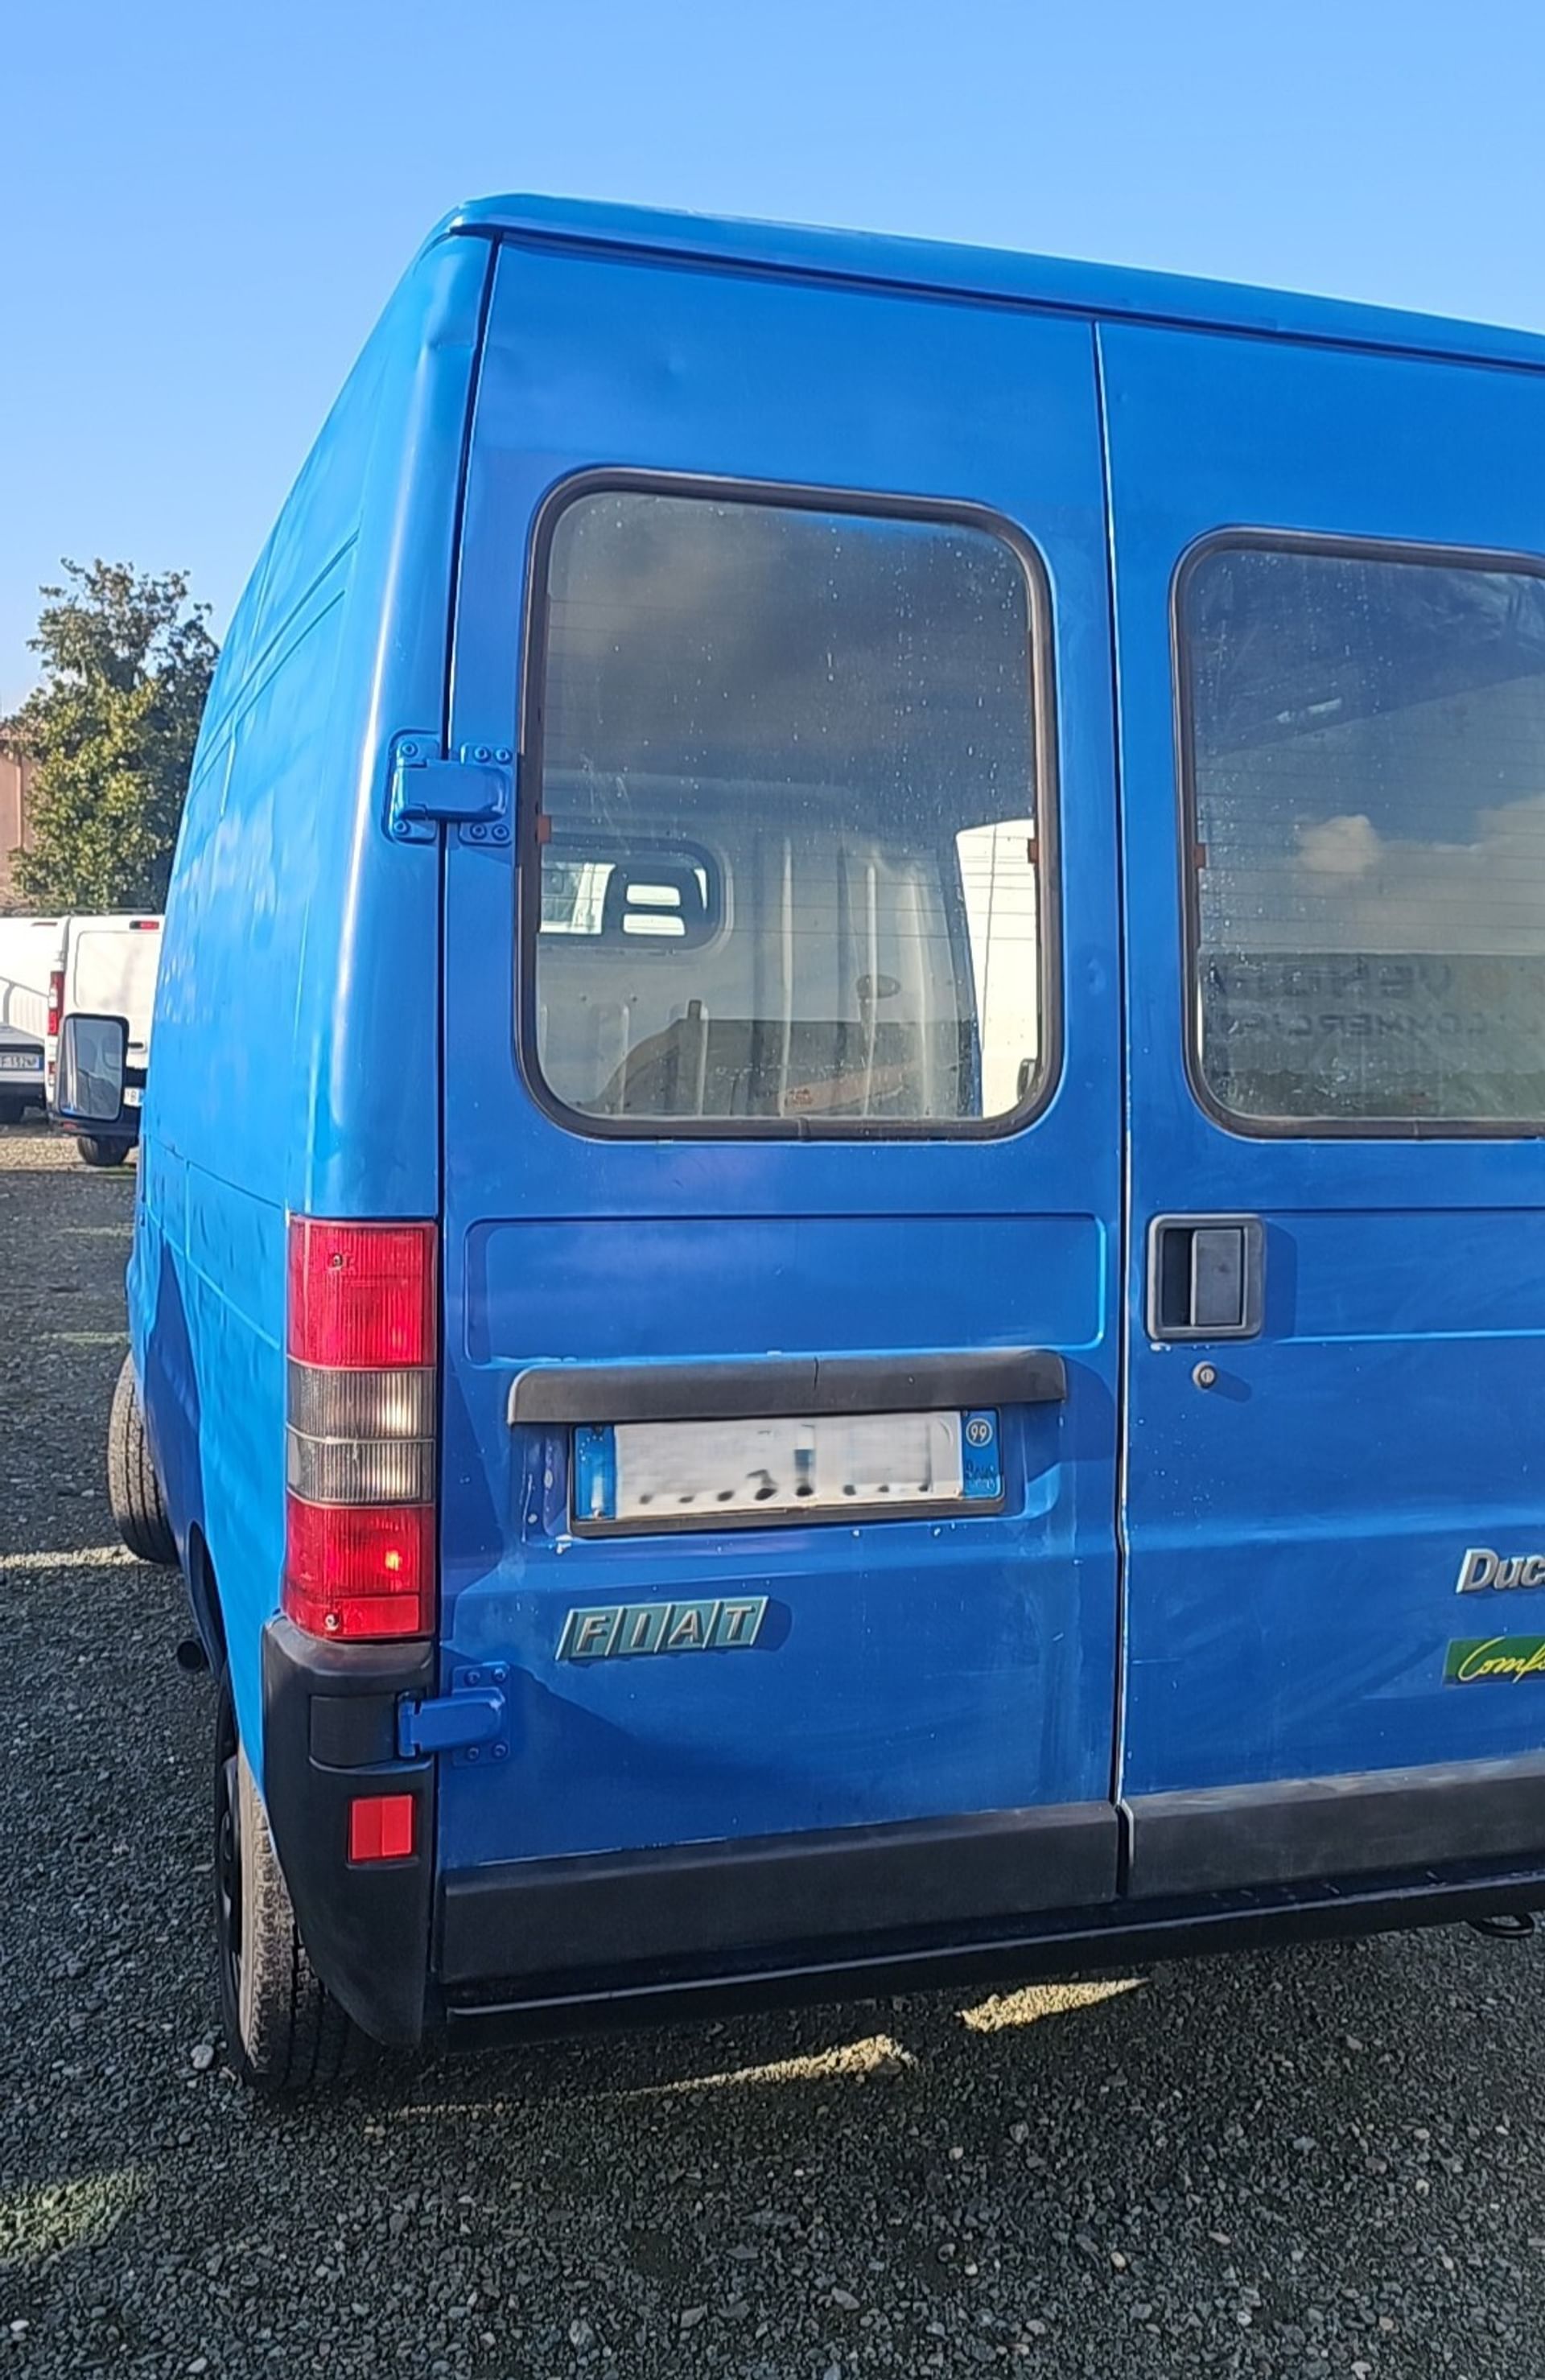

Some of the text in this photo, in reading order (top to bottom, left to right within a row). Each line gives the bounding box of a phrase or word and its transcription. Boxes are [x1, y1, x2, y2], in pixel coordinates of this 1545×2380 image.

[970, 1423, 987, 1443] 99
[1456, 1547, 1545, 1594] Duc
[575, 1604, 756, 1653] FIAT
